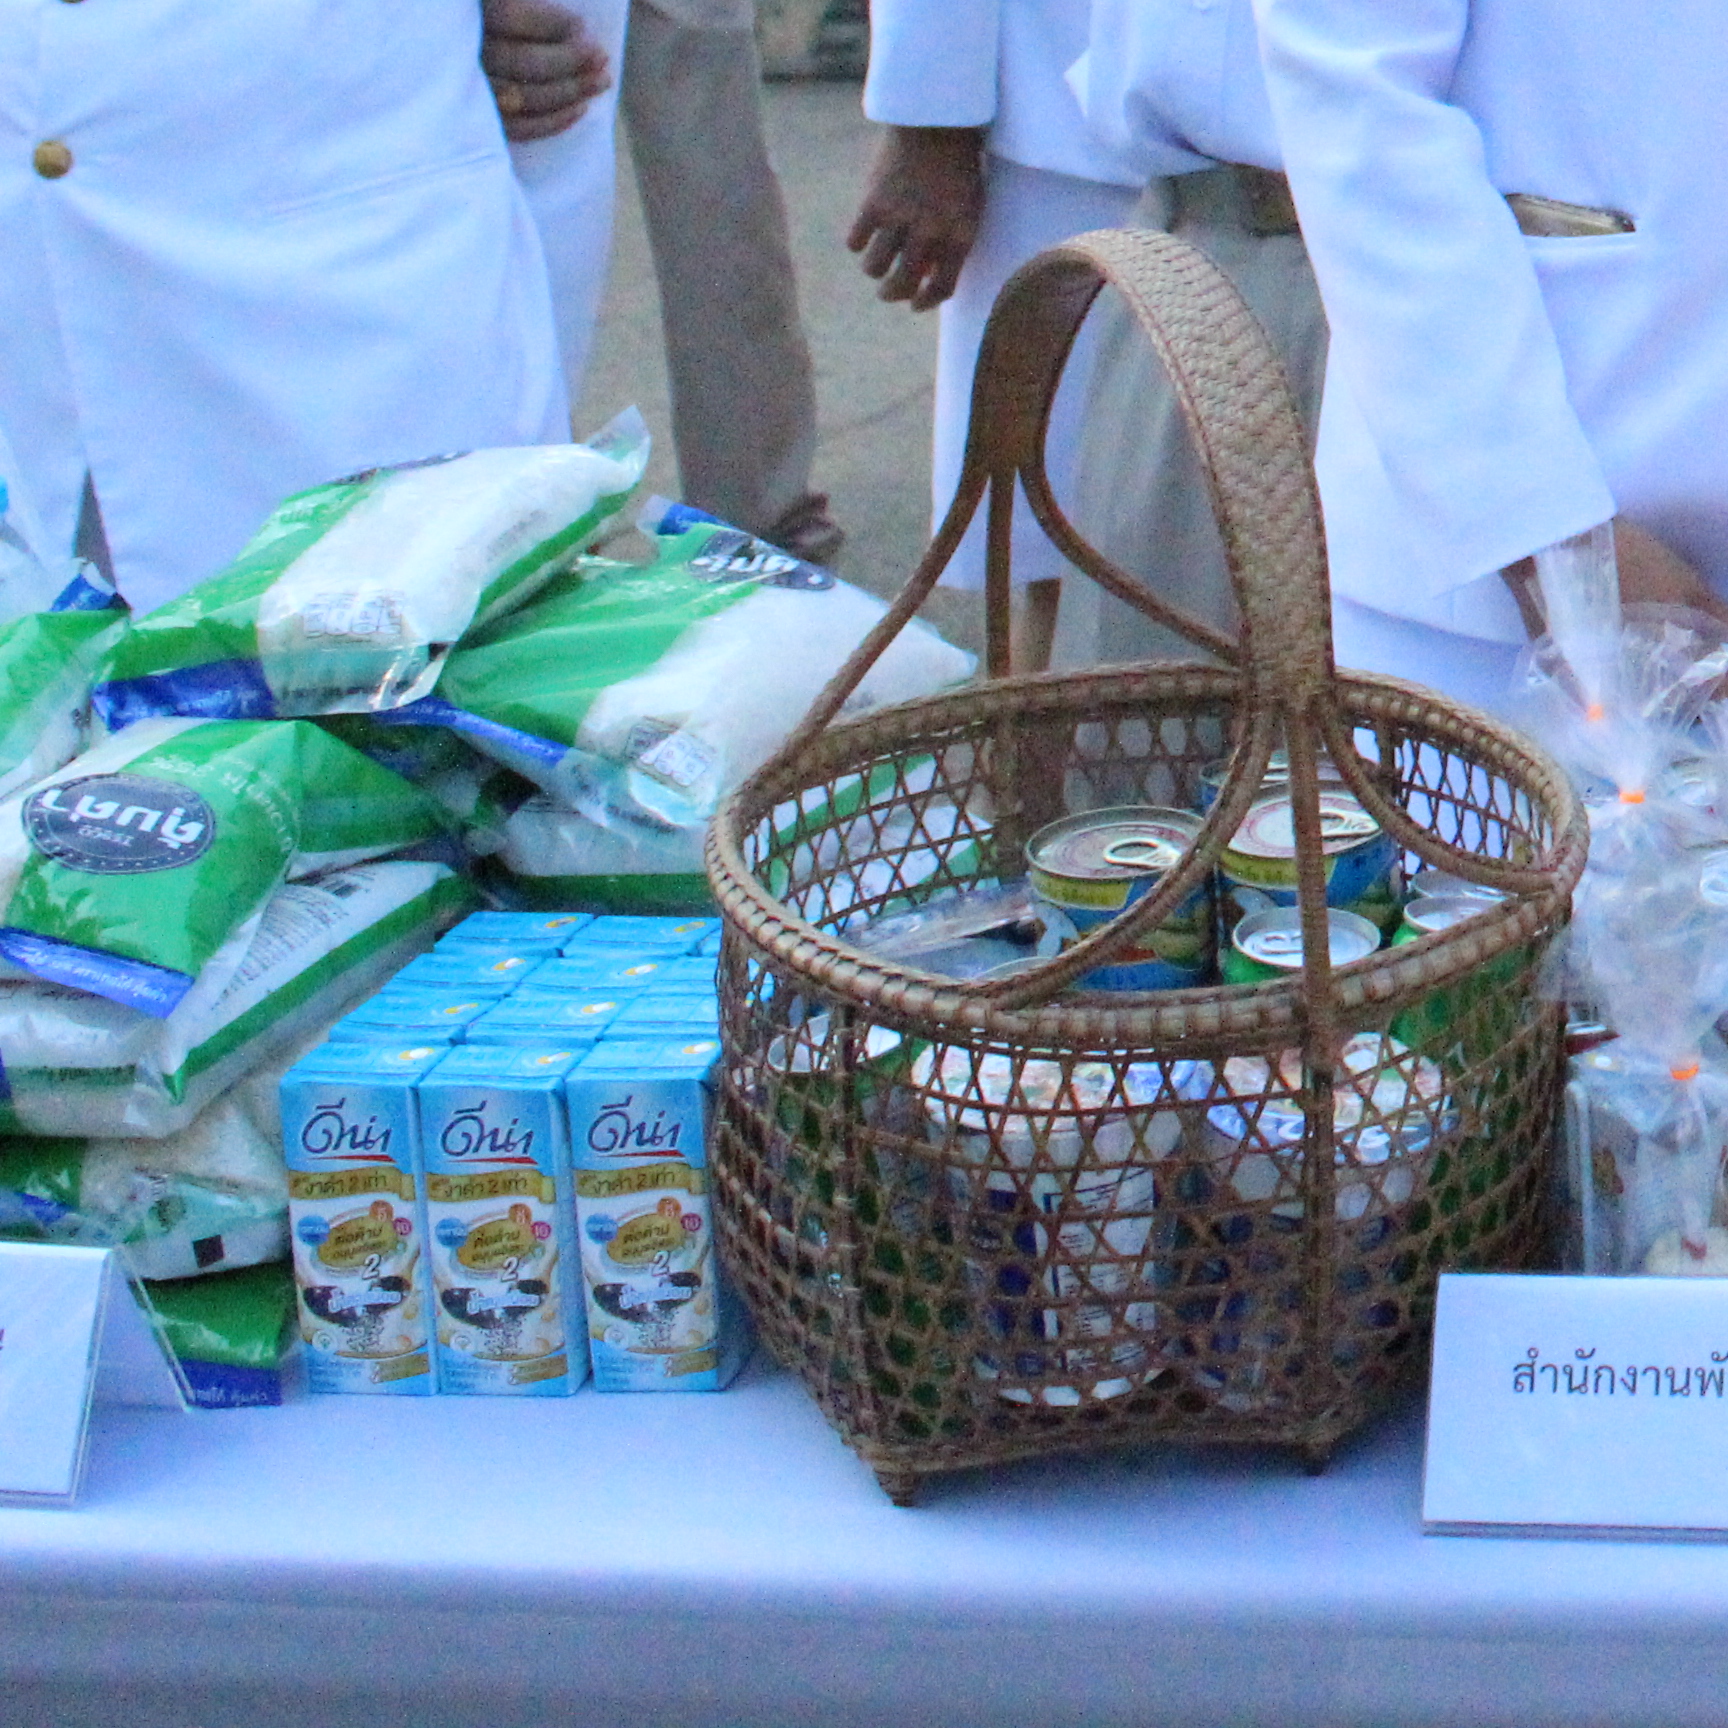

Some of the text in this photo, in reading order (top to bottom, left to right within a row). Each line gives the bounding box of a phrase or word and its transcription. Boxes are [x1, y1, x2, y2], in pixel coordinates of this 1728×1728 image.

[301, 1098, 392, 1154] ดีน่า
[441, 1101, 534, 1156] ดีน่า
[588, 1096, 682, 1152] ดีน่า
[363, 1254, 381, 1280] 2
[501, 1256, 520, 1283] 2
[652, 1250, 671, 1277] 2
